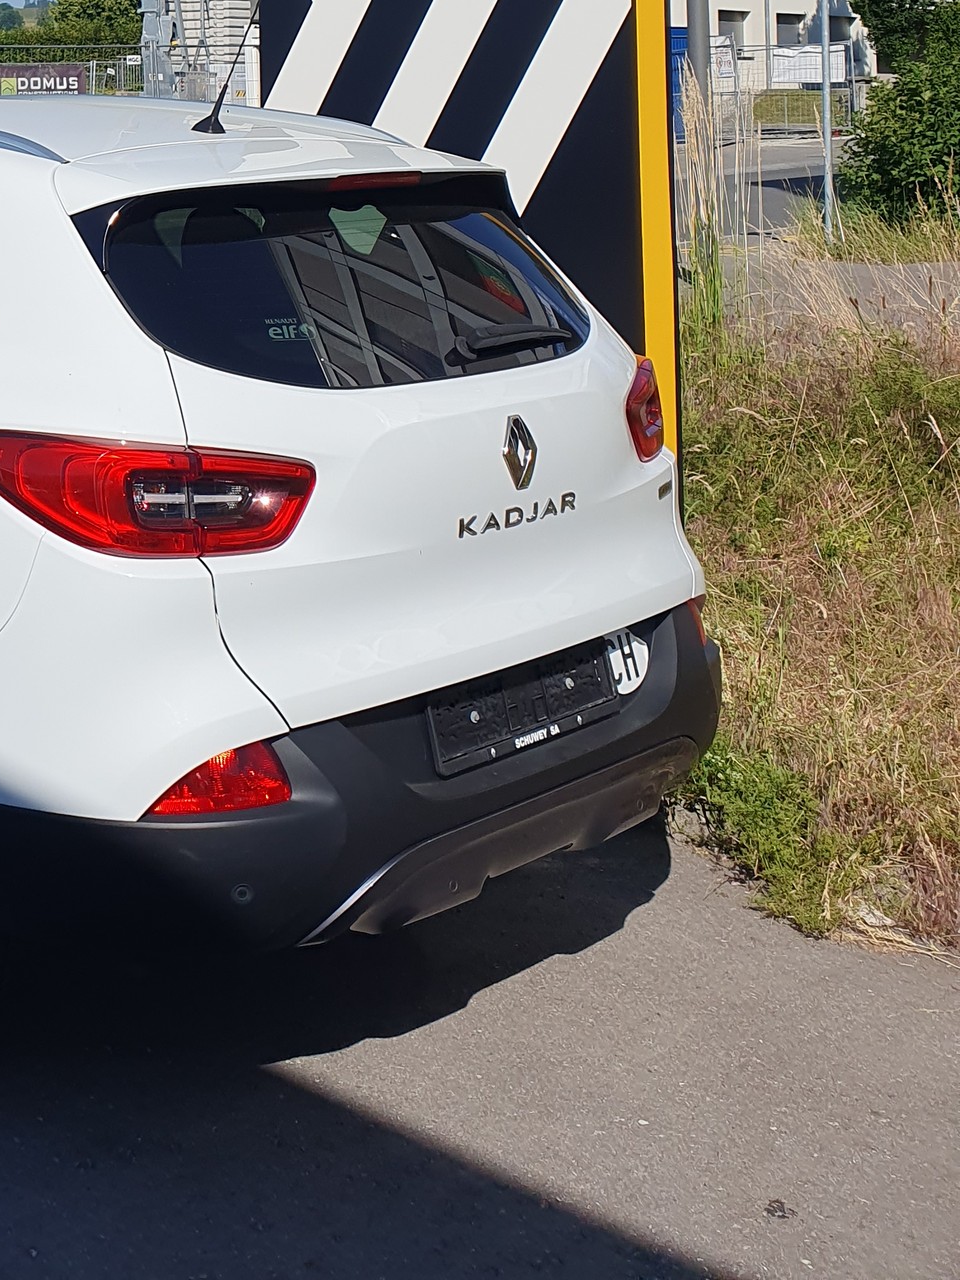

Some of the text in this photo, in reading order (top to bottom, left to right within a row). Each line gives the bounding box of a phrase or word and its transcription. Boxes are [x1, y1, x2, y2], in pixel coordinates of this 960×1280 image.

[17, 77, 79, 90] DOMUS
[268, 325, 297, 339] elf
[458, 491, 577, 539] KADJAR
[514, 724, 560, 749] SCHUWEY SA
